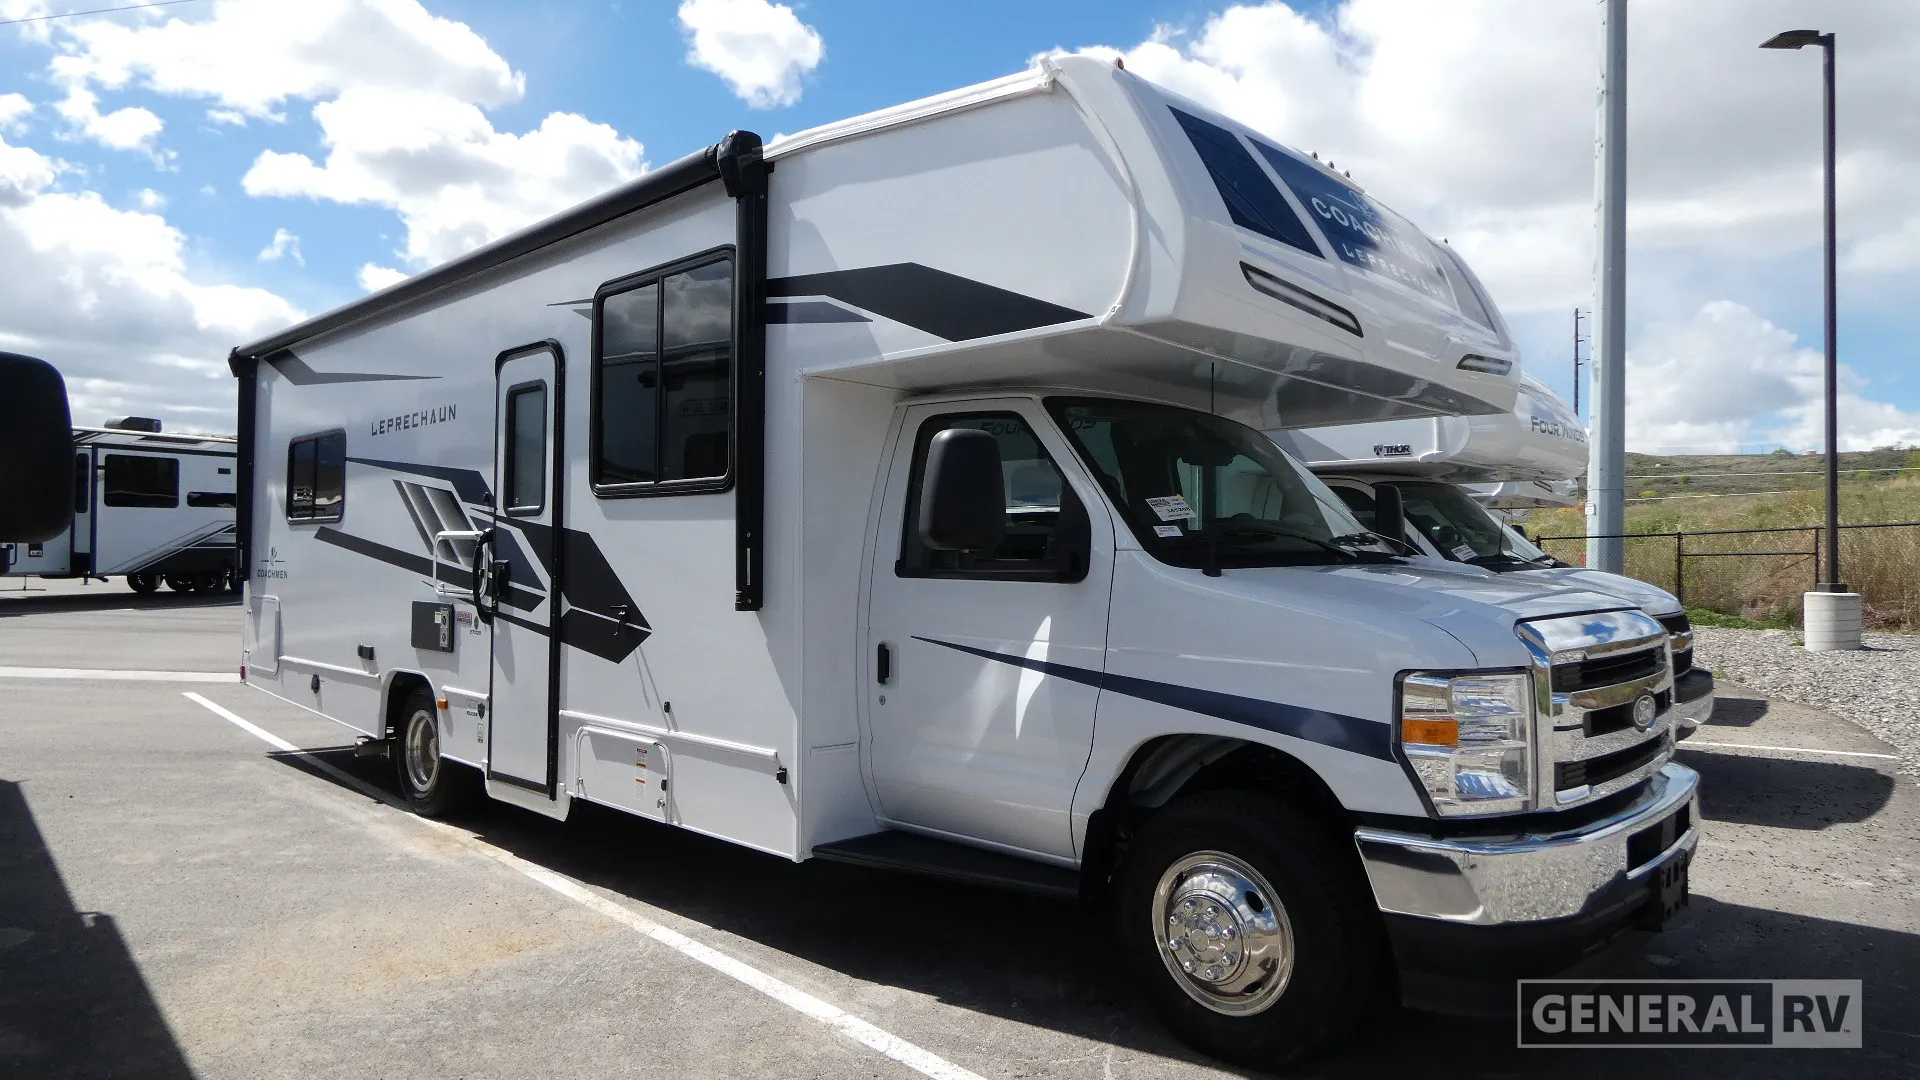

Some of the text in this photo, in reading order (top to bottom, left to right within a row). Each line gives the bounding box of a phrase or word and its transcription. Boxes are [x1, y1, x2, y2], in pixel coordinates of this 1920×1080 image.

[371, 404, 456, 436] LEPRECHAUN
[1530, 415, 1559, 437] FOUR
[1384, 444, 1411, 455] THOR
[257, 569, 288, 579] COACHMEN
